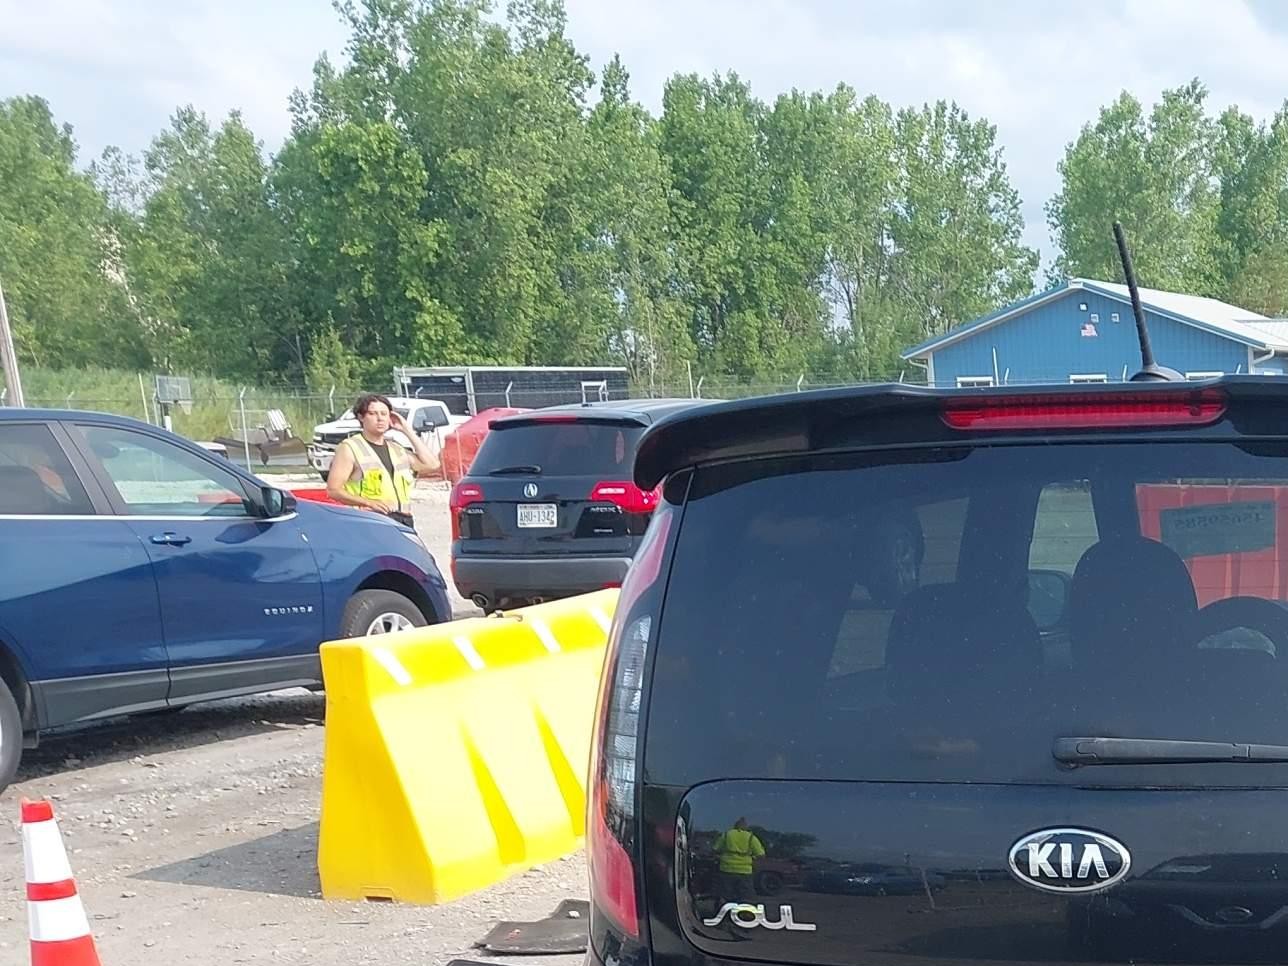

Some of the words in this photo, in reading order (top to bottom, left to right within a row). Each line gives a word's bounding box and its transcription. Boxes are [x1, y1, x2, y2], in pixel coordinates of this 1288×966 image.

[263, 605, 313, 616] EQUINOX
[1027, 842, 1110, 879] KIA
[702, 901, 817, 931] SOUL
